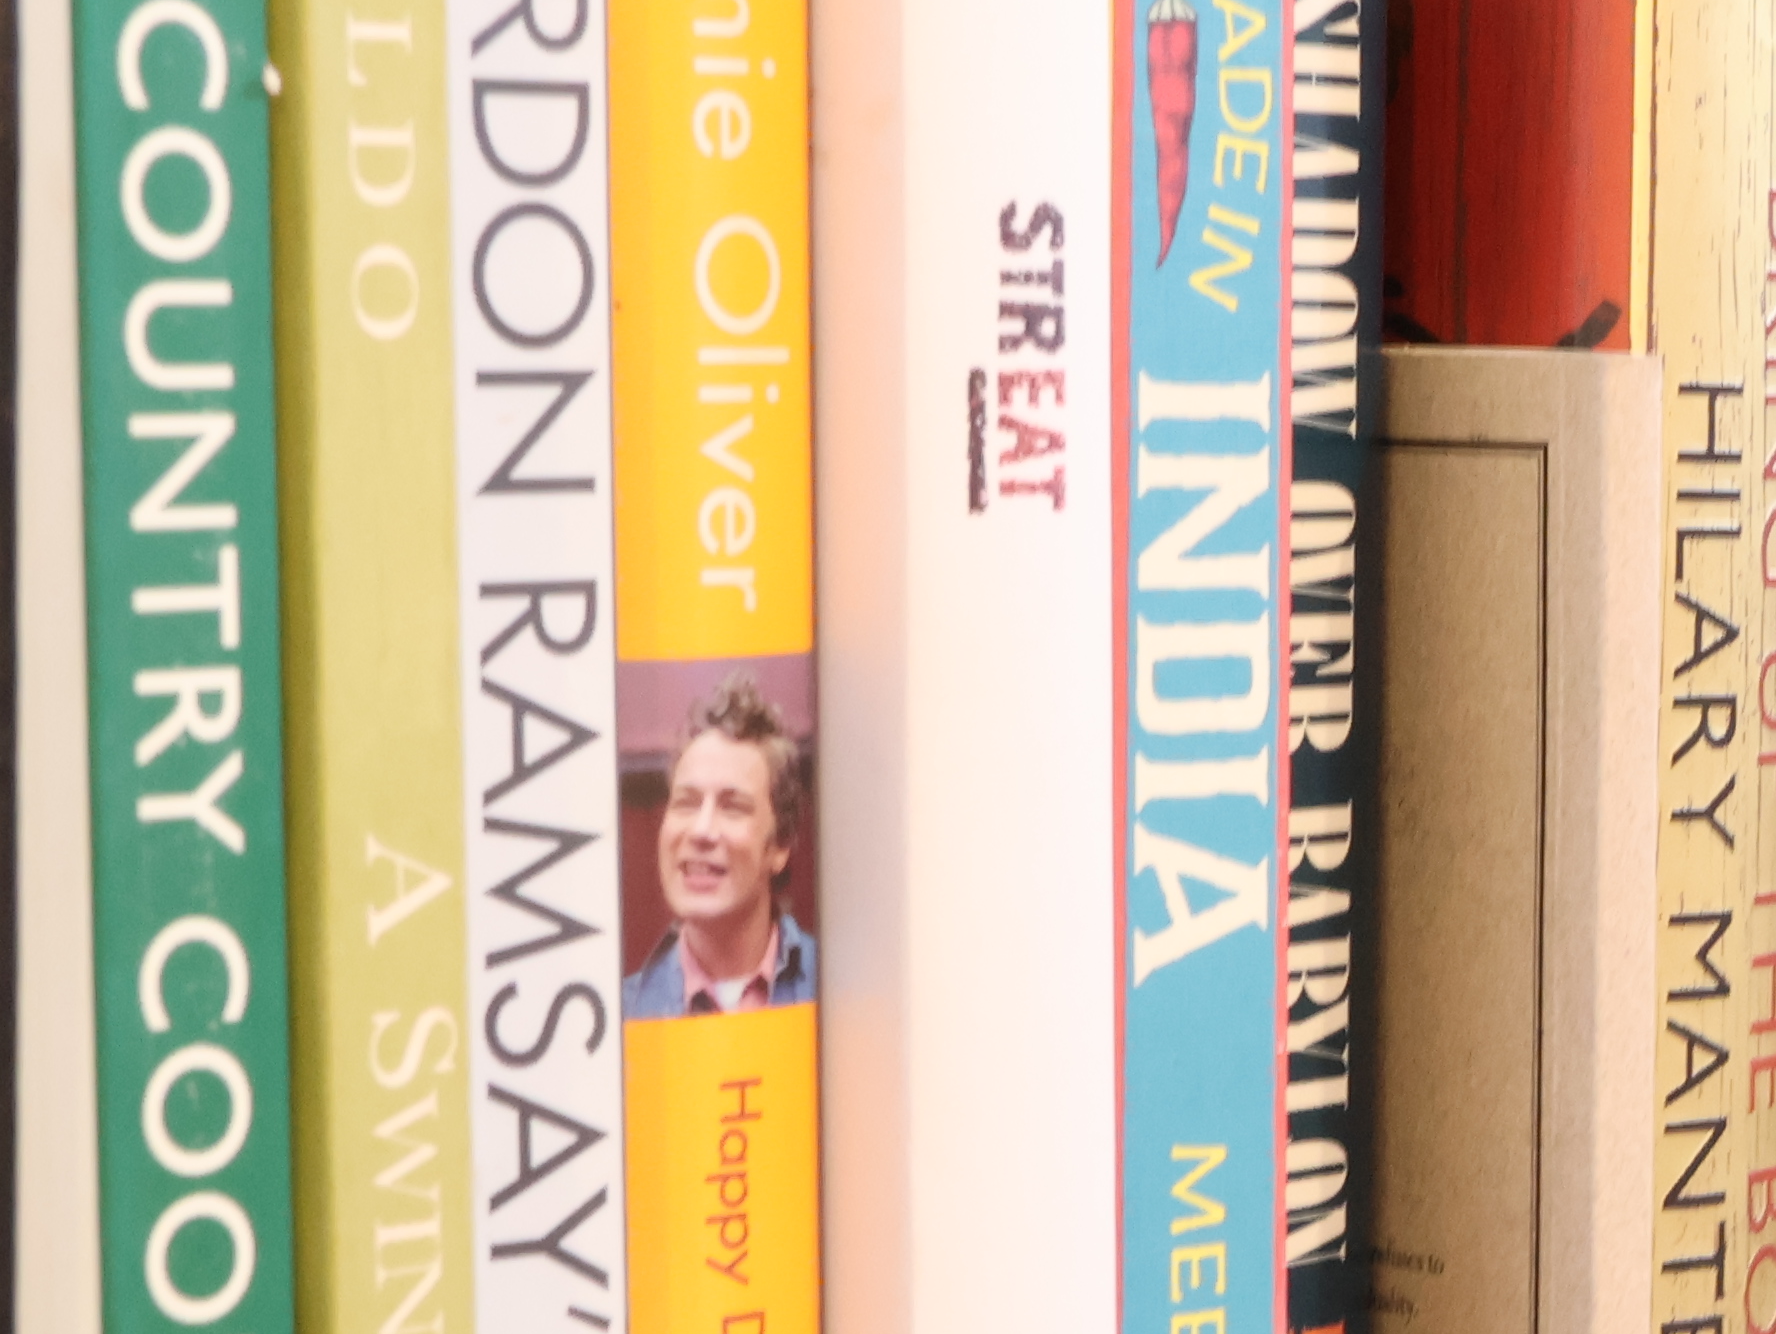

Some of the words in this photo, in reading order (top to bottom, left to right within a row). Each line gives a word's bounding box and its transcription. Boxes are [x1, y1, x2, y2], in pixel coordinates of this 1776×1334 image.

[1188, 204, 1260, 313] IN
[694, 215, 790, 613] Oliver
[1134, 369, 1271, 989] INDIA
[1668, 381, 1744, 850] HILARY
[366, 835, 454, 947] A
[705, 1075, 764, 1287] Happy
